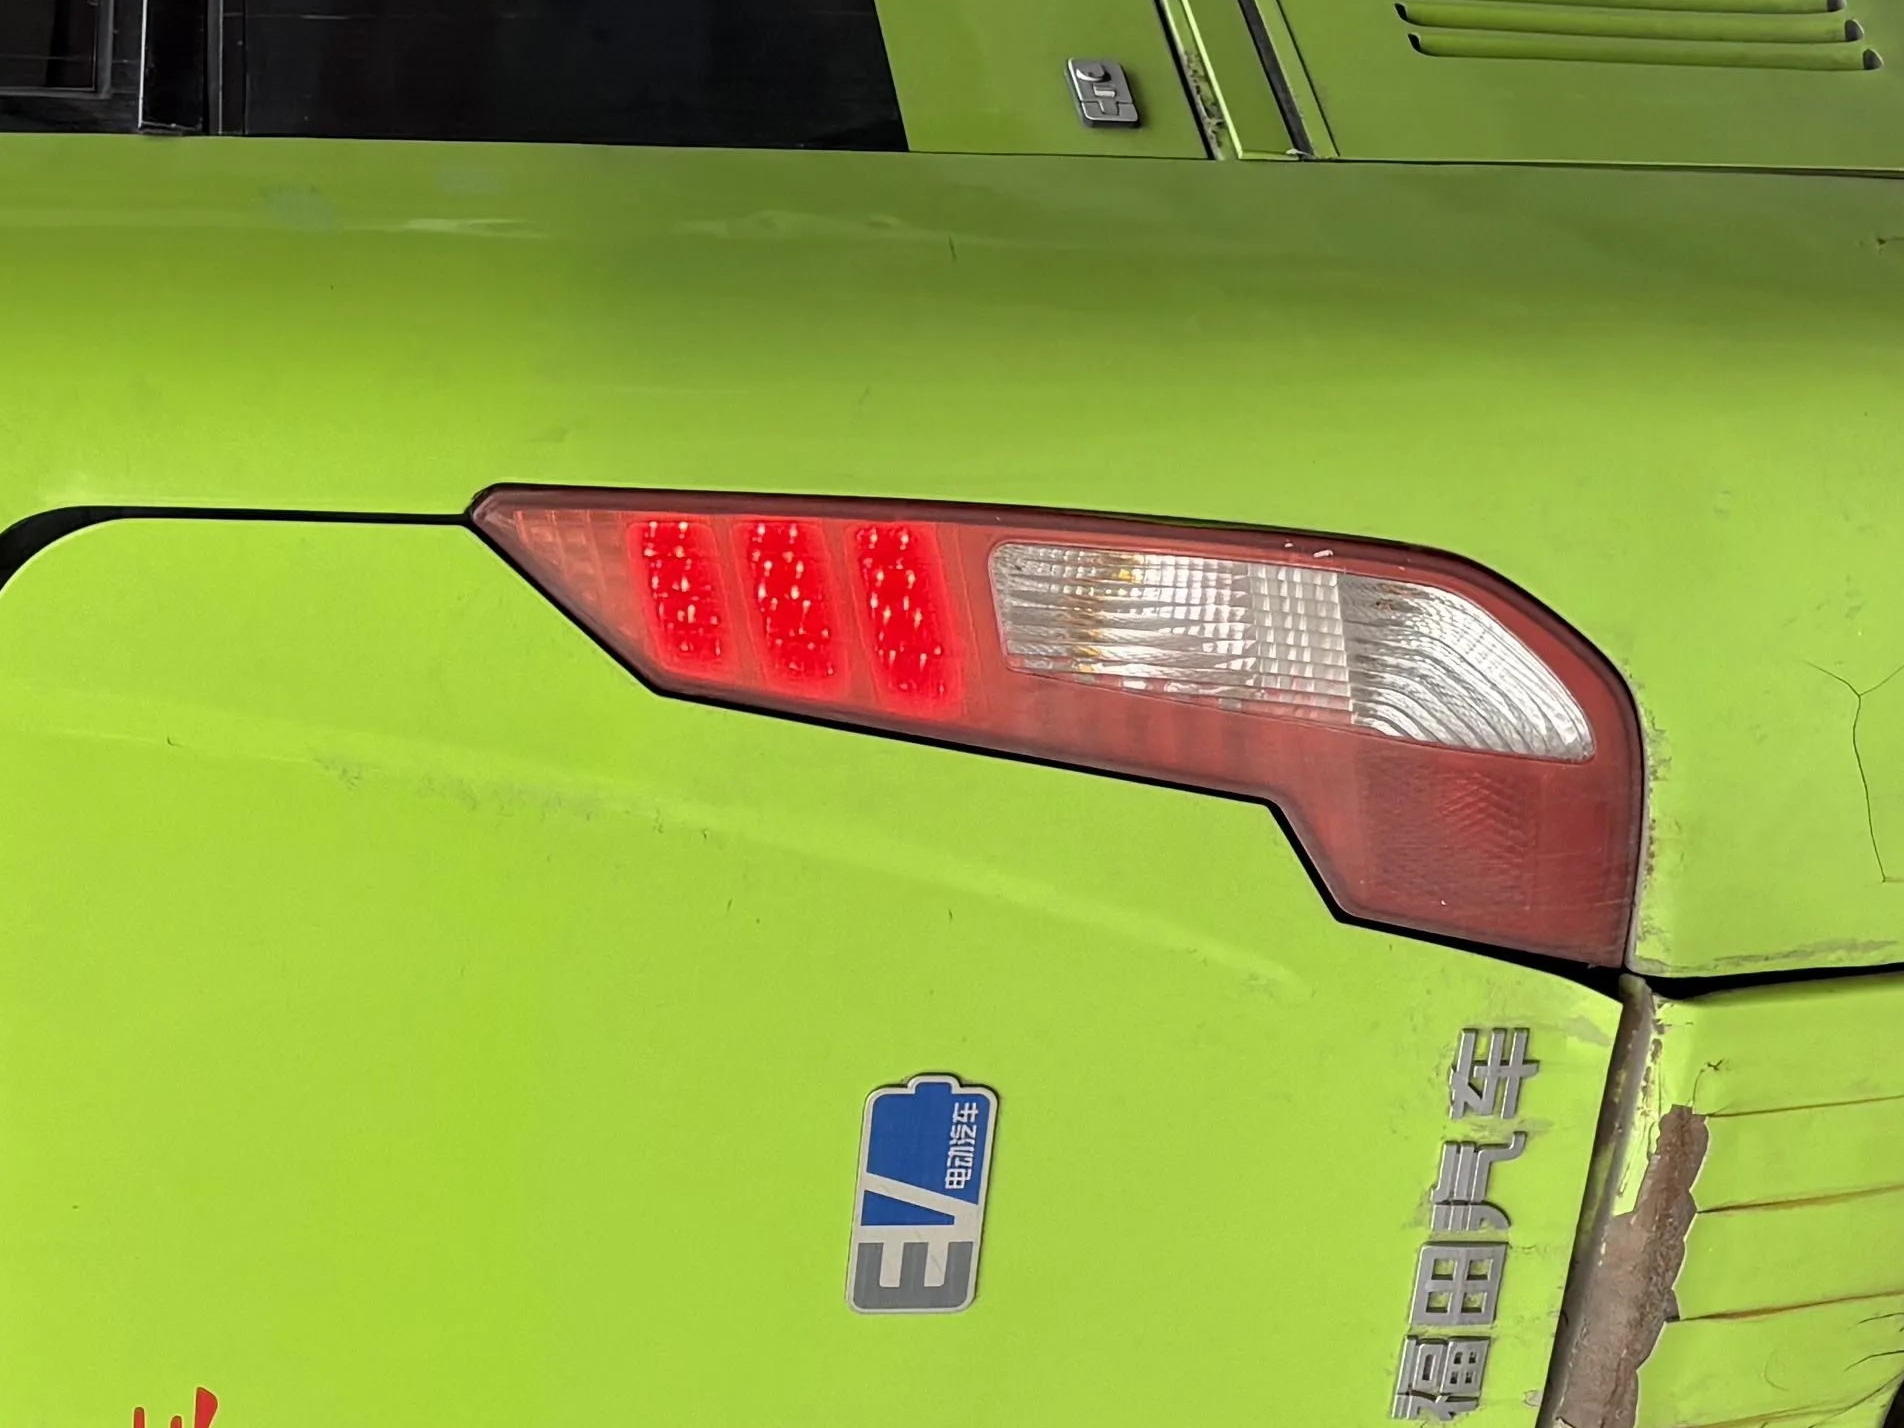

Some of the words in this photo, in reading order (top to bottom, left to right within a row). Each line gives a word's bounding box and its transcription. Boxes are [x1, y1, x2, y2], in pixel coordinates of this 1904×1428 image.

[945, 1102, 979, 1189] 电动汽车
[852, 1172, 977, 1310] EV
